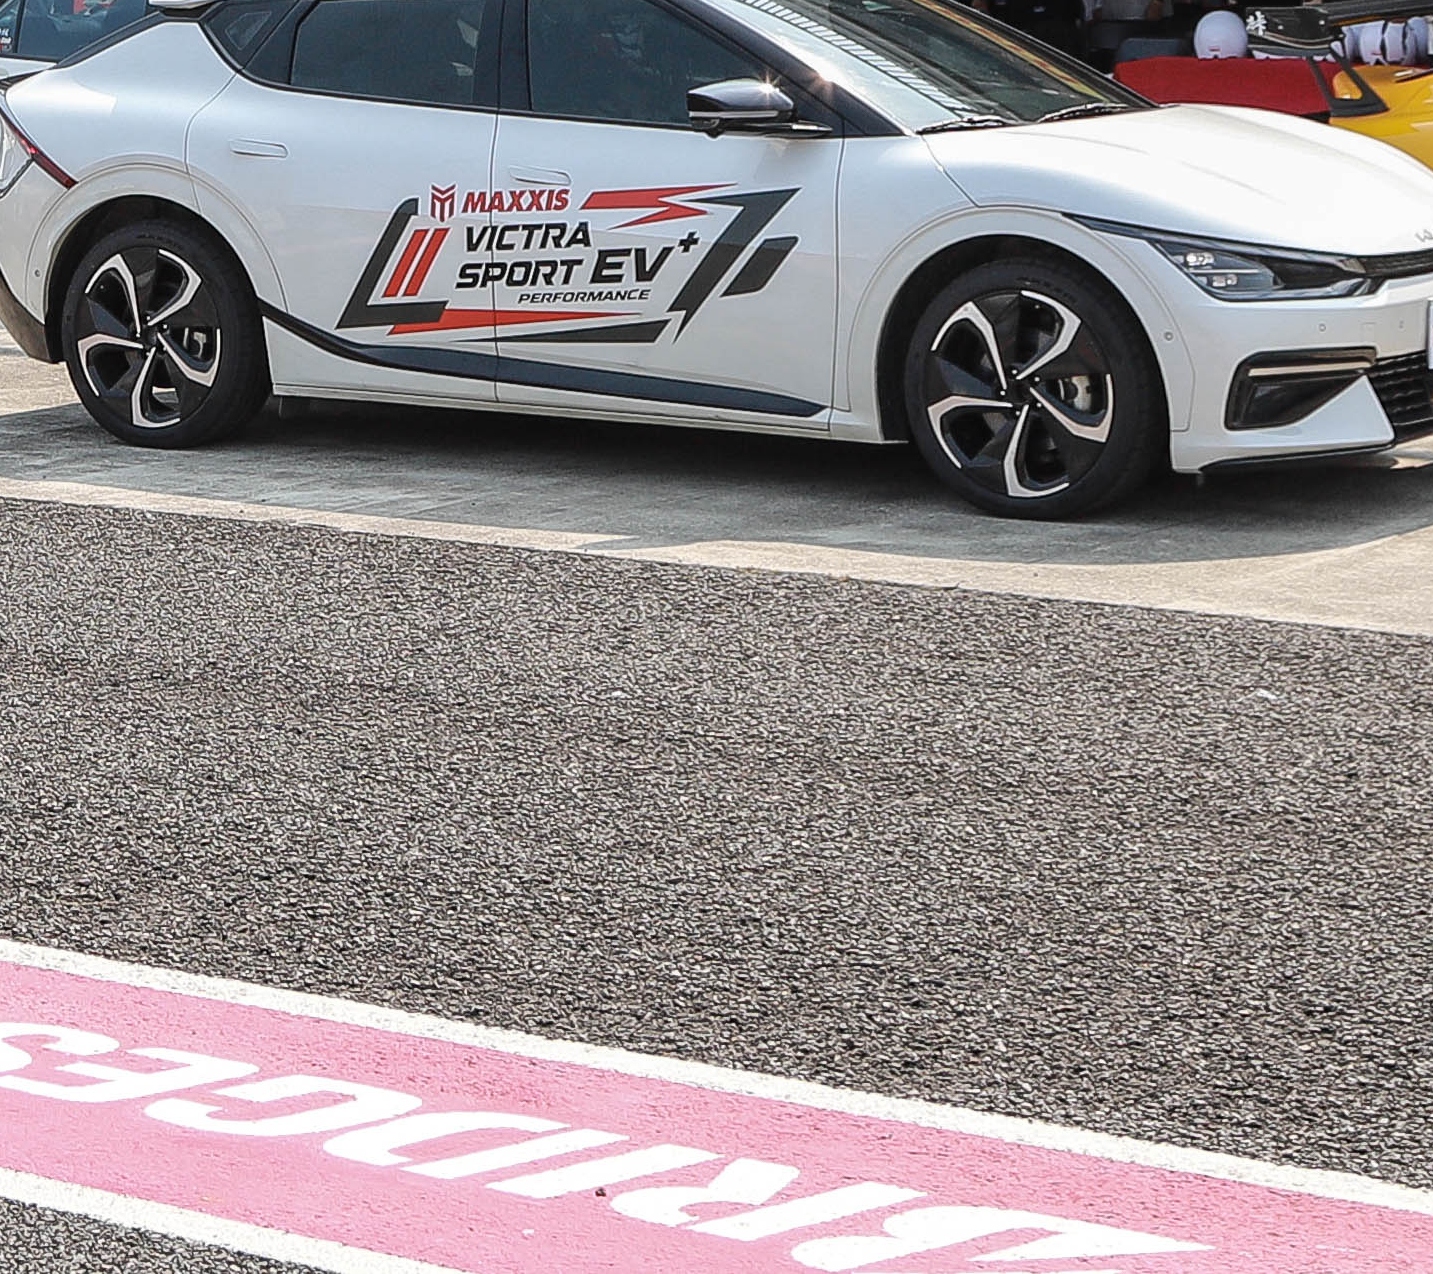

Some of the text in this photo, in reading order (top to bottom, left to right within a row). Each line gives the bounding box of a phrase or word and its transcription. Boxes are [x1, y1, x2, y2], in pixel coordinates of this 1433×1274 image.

[462, 188, 571, 214] MAXXIS
[464, 221, 592, 252] VICTRA
[455, 258, 585, 289] SPORT
[517, 288, 651, 305] PERFORMANCE
